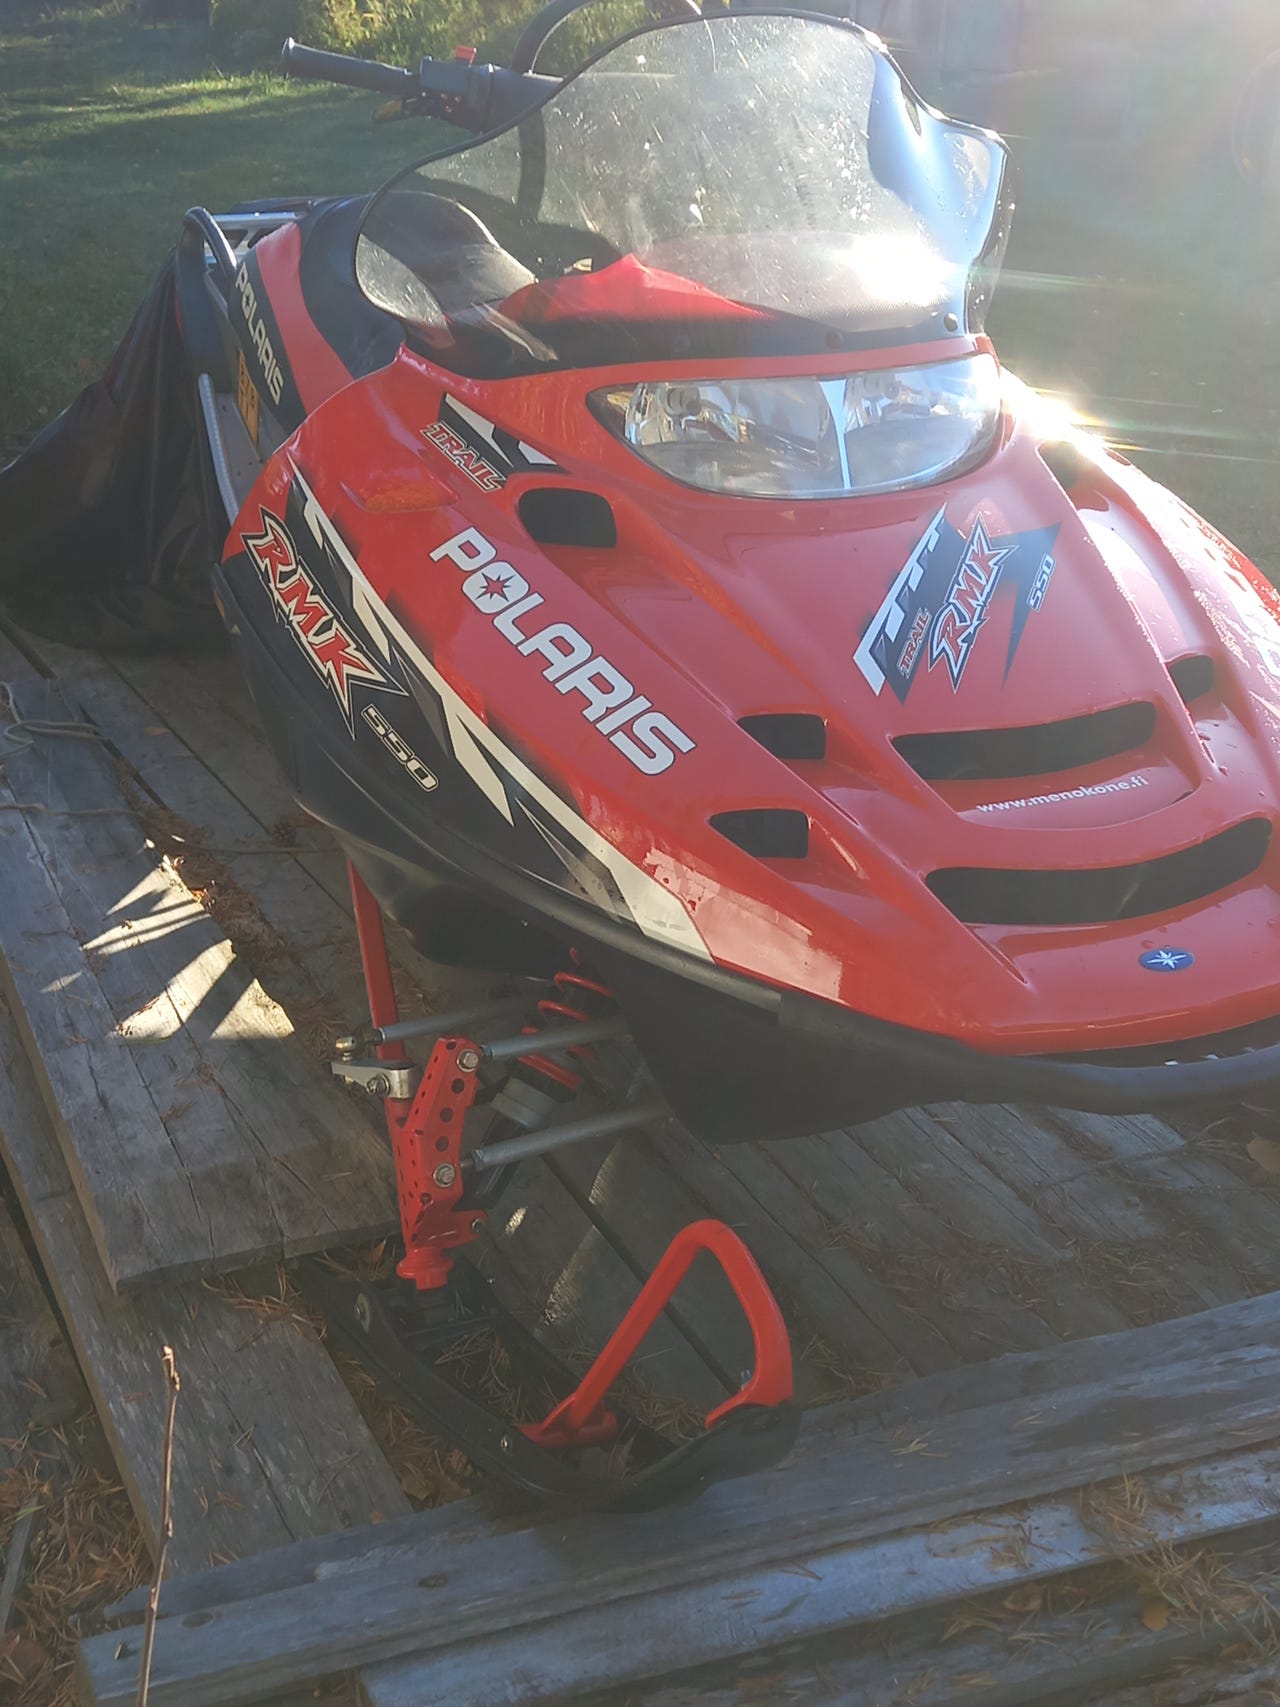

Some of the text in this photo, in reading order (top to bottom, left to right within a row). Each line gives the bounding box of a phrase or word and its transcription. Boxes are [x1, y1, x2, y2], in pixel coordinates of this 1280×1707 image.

[235, 261, 284, 405] POLARIS
[420, 420, 507, 493] TRAIL
[241, 506, 402, 736] RMK
[928, 512, 1018, 694] RMK
[1027, 553, 1056, 612] 550
[429, 527, 696, 776] POLARIS
[897, 608, 931, 679] TRAIL
[361, 703, 439, 792] 550
[976, 776, 1148, 813] www.menokone.fi
